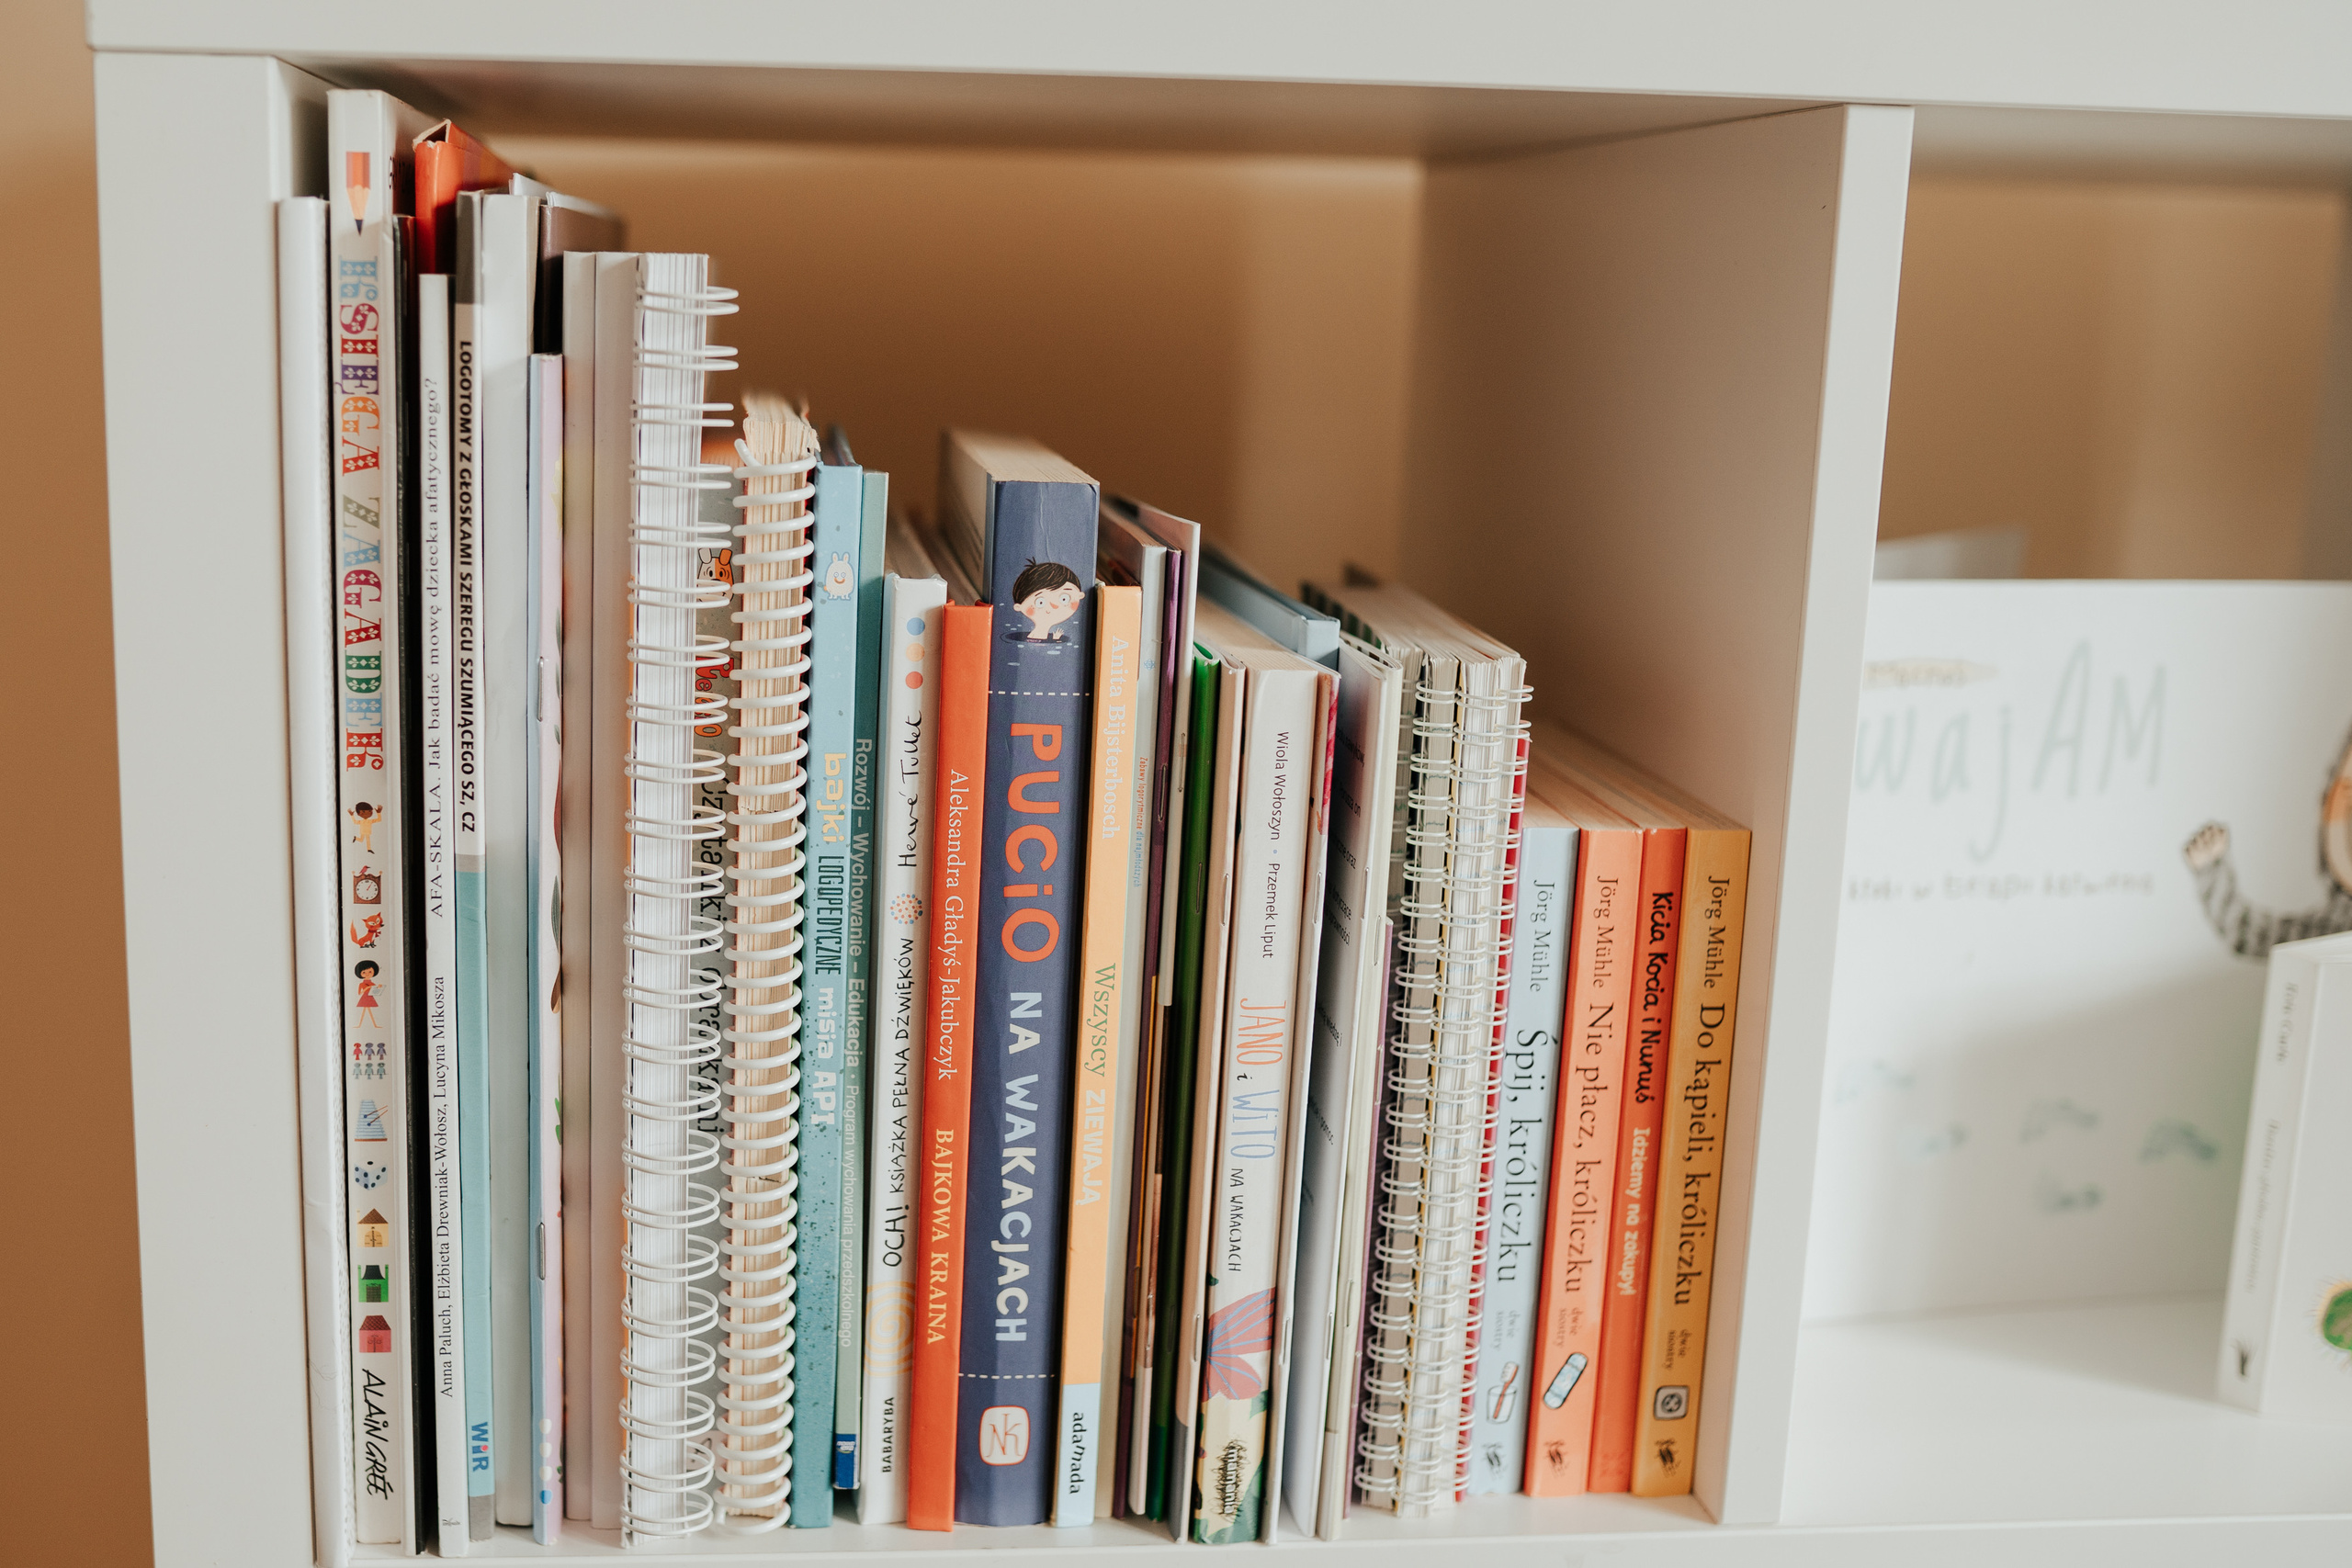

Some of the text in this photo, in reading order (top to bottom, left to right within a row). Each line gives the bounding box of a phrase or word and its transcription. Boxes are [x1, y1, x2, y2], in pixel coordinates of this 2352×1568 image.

[335, 254, 384, 773] KSIĘGA ZAGADEK
[458, 340, 475, 832] LOGOTOMY Z GŁOSKAMI SZEREGU SZUMIĄCEGO SZ, CZ
[424, 378, 443, 919] AFA-SKALA. Jak badać mowę dziecka afatycznego?
[852, 738, 873, 810] Rozwój
[1102, 636, 1129, 840] Anita Bijsterbosch
[1261, 732, 1290, 959] Wiola Wołoszyn Przemek Liput
[849, 832, 870, 956] Wychowanie
[933, 769, 969, 1081] Aleksandra Gładyś-Jakubczyk
[1530, 880, 1555, 993] Jörg Mühle
[1649, 892, 1673, 945] Kicia
[810, 752, 847, 1125] bajki LOGOPEDYCZNE misia API
[1643, 952, 1669, 1011] Kocia
[843, 978, 865, 1067] Edukacja
[1008, 992, 1043, 1055] NA
[1236, 998, 1286, 1066] JANO
[1634, 1030, 1661, 1103] Nunuś
[842, 1085, 860, 1145] Program
[892, 1048, 910, 1108] PEŁNA
[1075, 963, 1116, 1206] Wszyscy ZIEWAJĄ
[1237, 1072, 1253, 1081] i
[1565, 875, 1619, 1293] Jörg Mühle Nie płacz, króliczku
[1673, 875, 1731, 1305] Jörg Mühle Do kąpieli, króliczku
[432, 976, 454, 1398] Anna Paluch, Elżbieta Drewniak-Wołosz, Lucyna Mikosza
[842, 1148, 858, 1235] wychowania
[1229, 1168, 1245, 1188] NA
[1496, 1029, 1559, 1283] Śpij, króliczku
[1624, 1126, 1651, 1198] Idziemy
[882, 1203, 910, 1268] OCH!
[927, 1129, 955, 1345] BAJKOWA KRAINA
[990, 1073, 1040, 1342] WAKACJACH
[1227, 1194, 1245, 1272] WAKACJACH
[1624, 1203, 1643, 1225] na
[839, 1241, 857, 1348] przedszkolnego
[1615, 1231, 1639, 1295] zakupy!
[882, 1396, 895, 1473] BABARYBA
[1069, 1412, 1088, 1495] adamada
